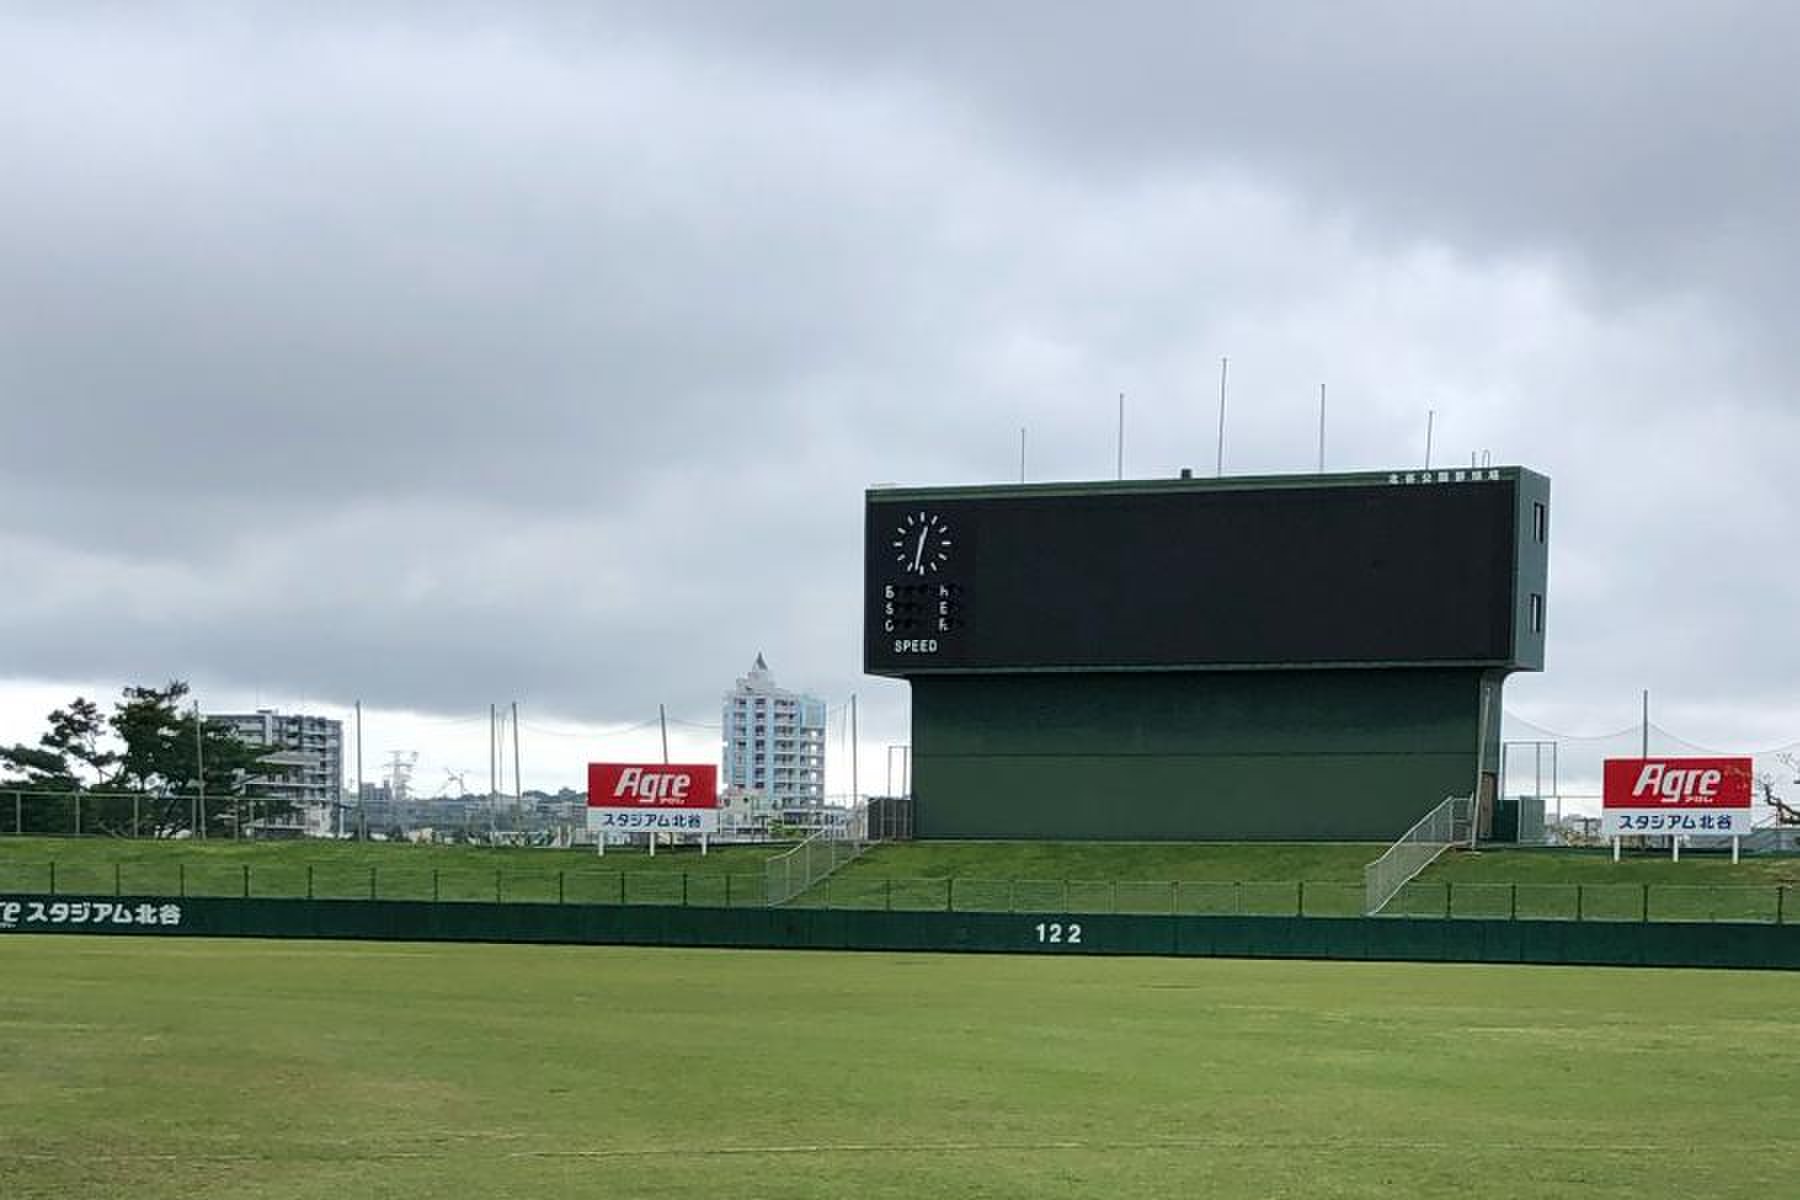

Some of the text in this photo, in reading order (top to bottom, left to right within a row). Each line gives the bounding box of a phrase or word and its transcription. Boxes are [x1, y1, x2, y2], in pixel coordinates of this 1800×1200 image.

[895, 639, 938, 653] SPEED
[613, 767, 691, 803] Agre
[1632, 763, 1721, 803] Agre
[602, 813, 702, 828] スタジアム北谷
[1619, 814, 1732, 830] スタジアム北谷
[26, 902, 182, 925] スタジアム北谷
[1035, 923, 1081, 943] 122
